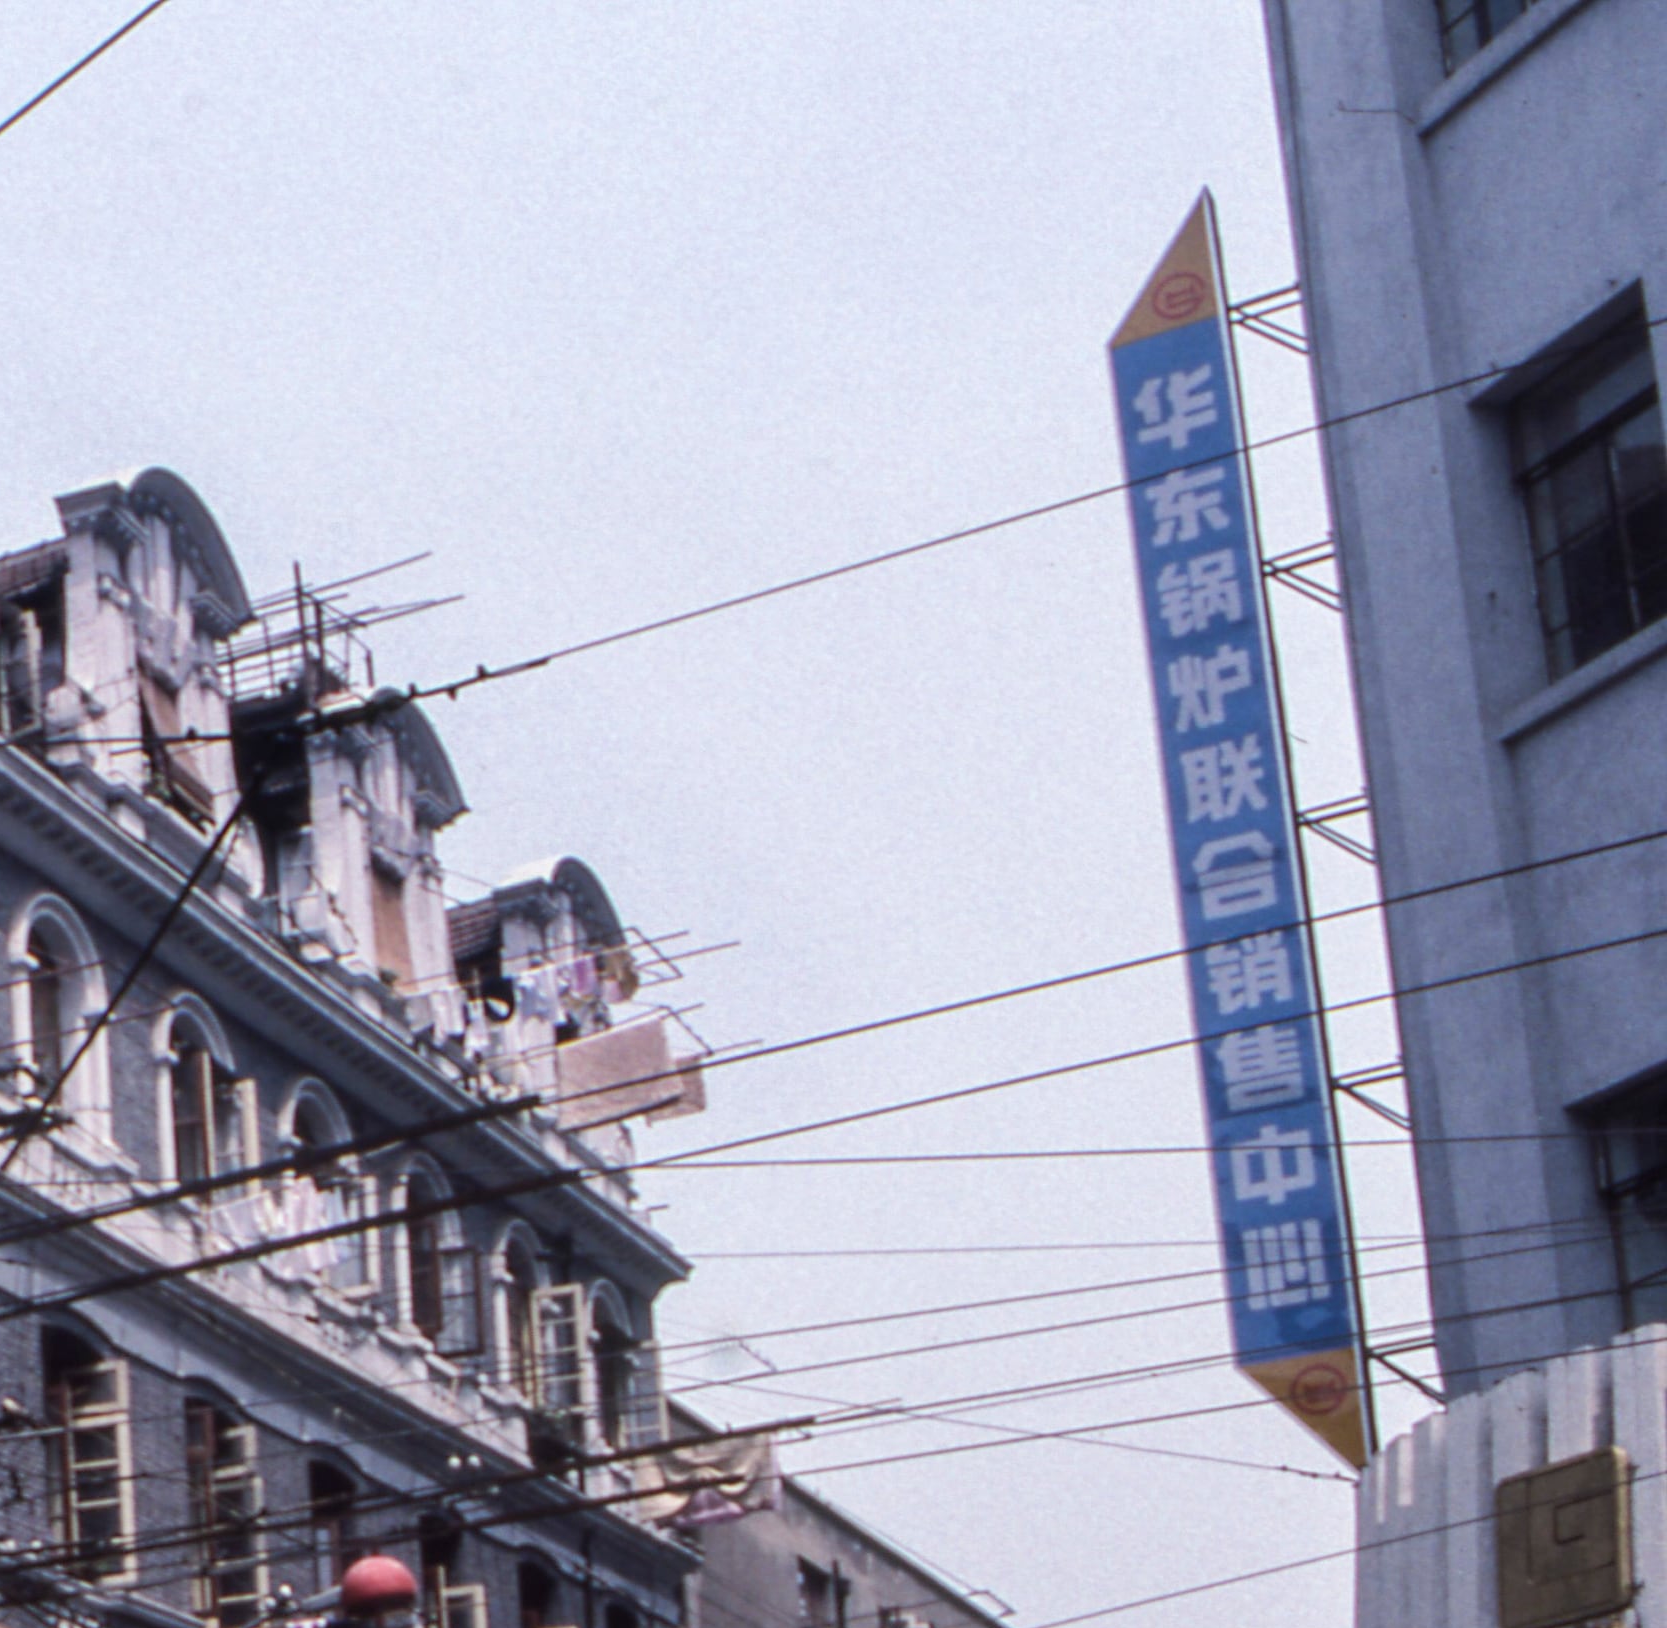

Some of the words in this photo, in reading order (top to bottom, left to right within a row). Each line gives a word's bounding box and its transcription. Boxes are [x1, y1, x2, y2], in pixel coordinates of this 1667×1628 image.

[1134, 363, 1330, 1311] 华东锅炉联合销售中心
